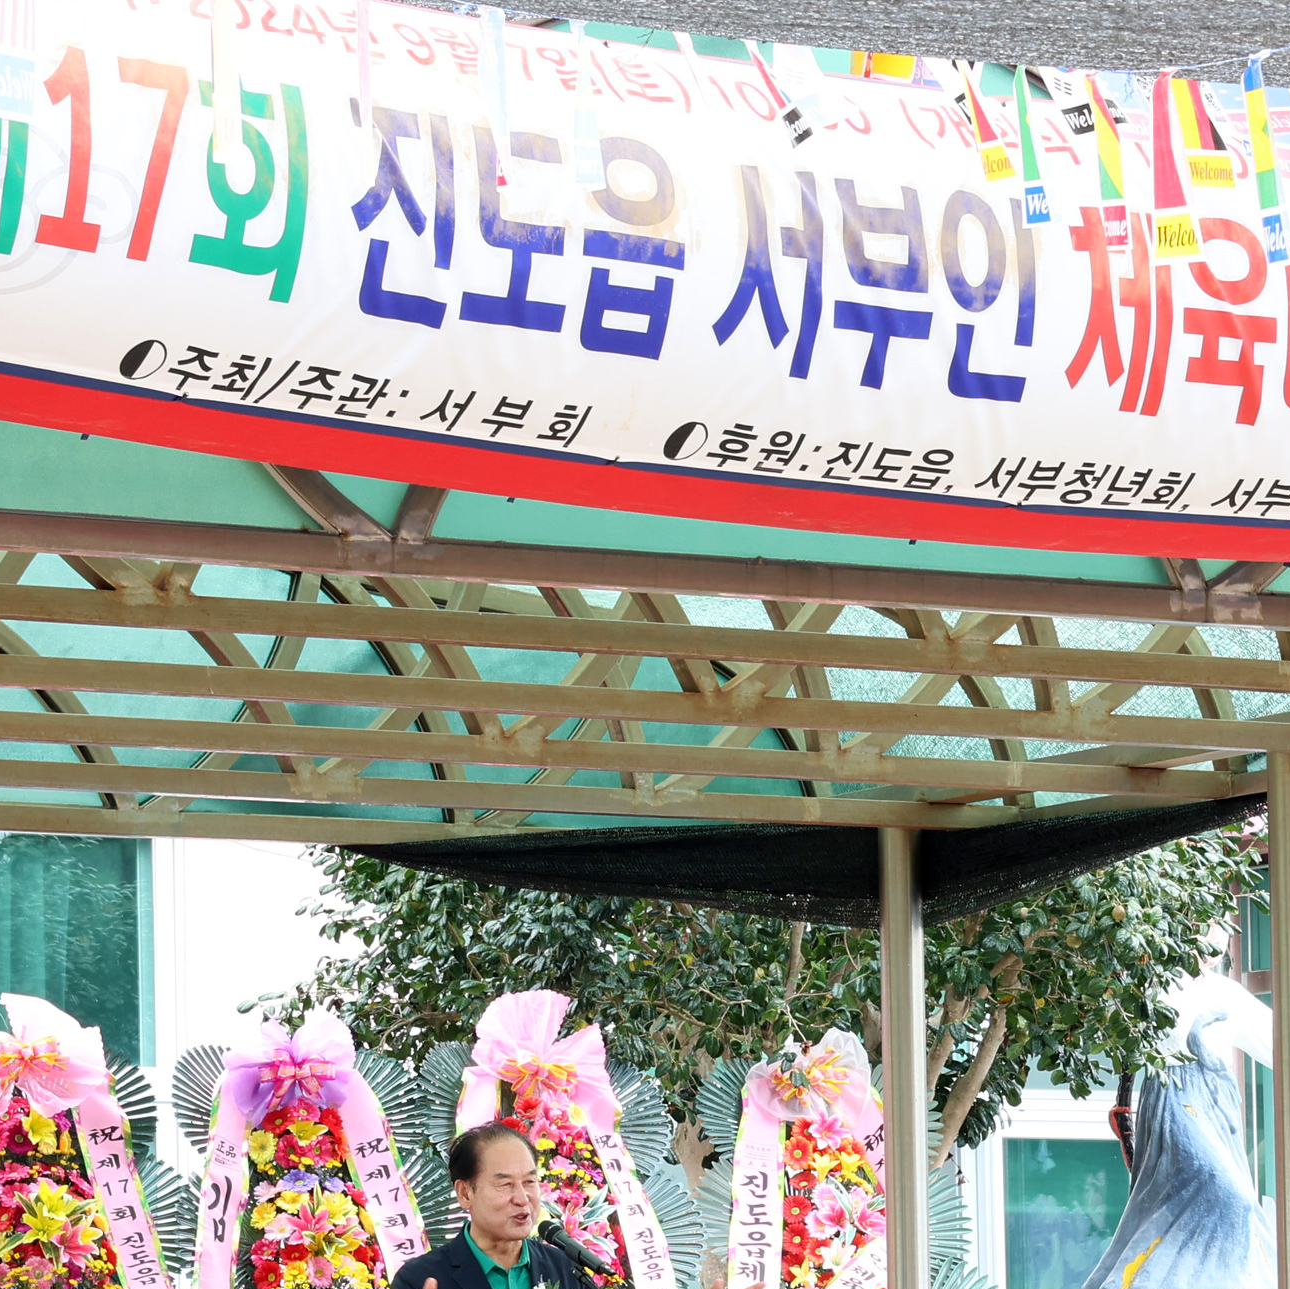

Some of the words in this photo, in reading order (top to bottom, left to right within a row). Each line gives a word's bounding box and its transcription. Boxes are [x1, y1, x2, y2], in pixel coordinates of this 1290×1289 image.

[1188, 159, 1234, 181] Welcome
[349, 97, 686, 360] 진도읍
[713, 163, 1037, 403] 서부인
[1156, 223, 1197, 249] Welco
[355, 1136, 390, 1160] 祝
[88, 1125, 125, 1146] 祝
[118, 1231, 163, 1286] 진도읍
[632, 1225, 667, 1282] 진도읍
